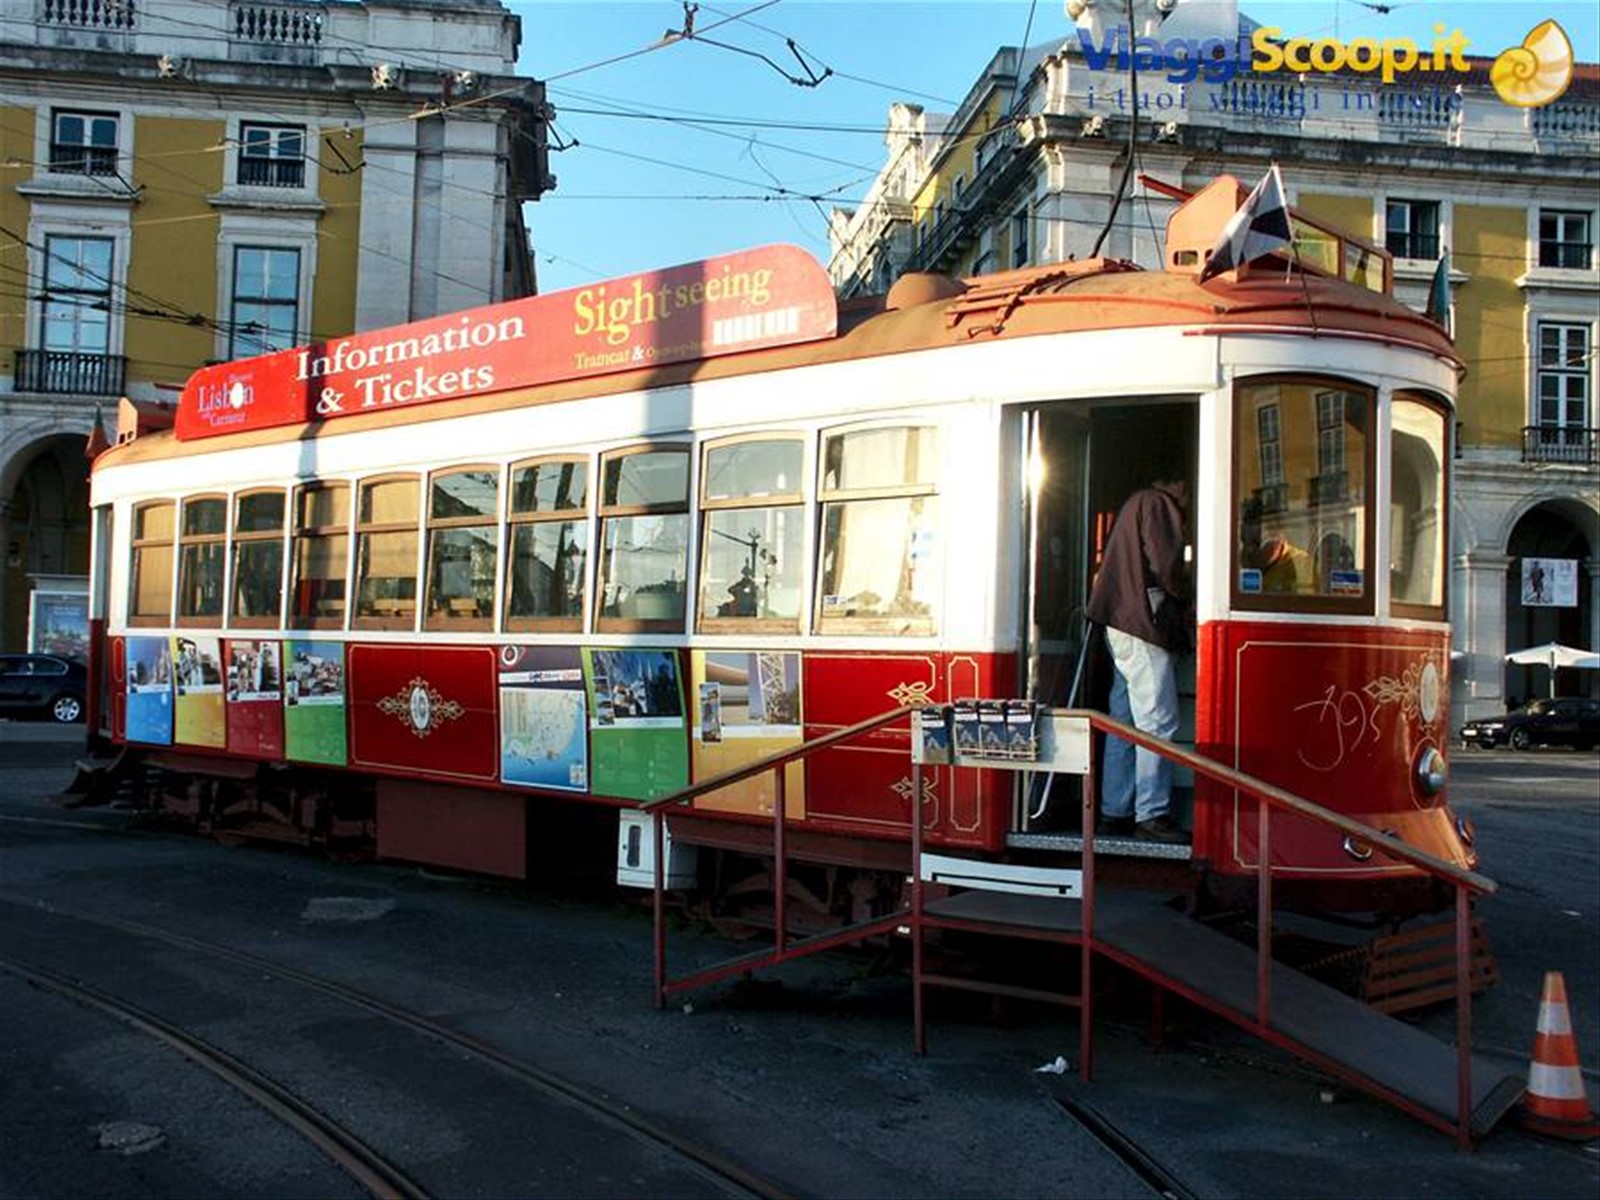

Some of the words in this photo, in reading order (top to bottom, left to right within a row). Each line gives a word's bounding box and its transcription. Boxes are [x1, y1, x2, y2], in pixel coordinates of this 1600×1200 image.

[573, 264, 772, 346] Sightseeing
[296, 315, 526, 381] Information
[632, 344, 645, 360] &
[198, 380, 255, 412] Lisbon
[316, 386, 344, 414] &
[354, 363, 495, 408] Tickets
